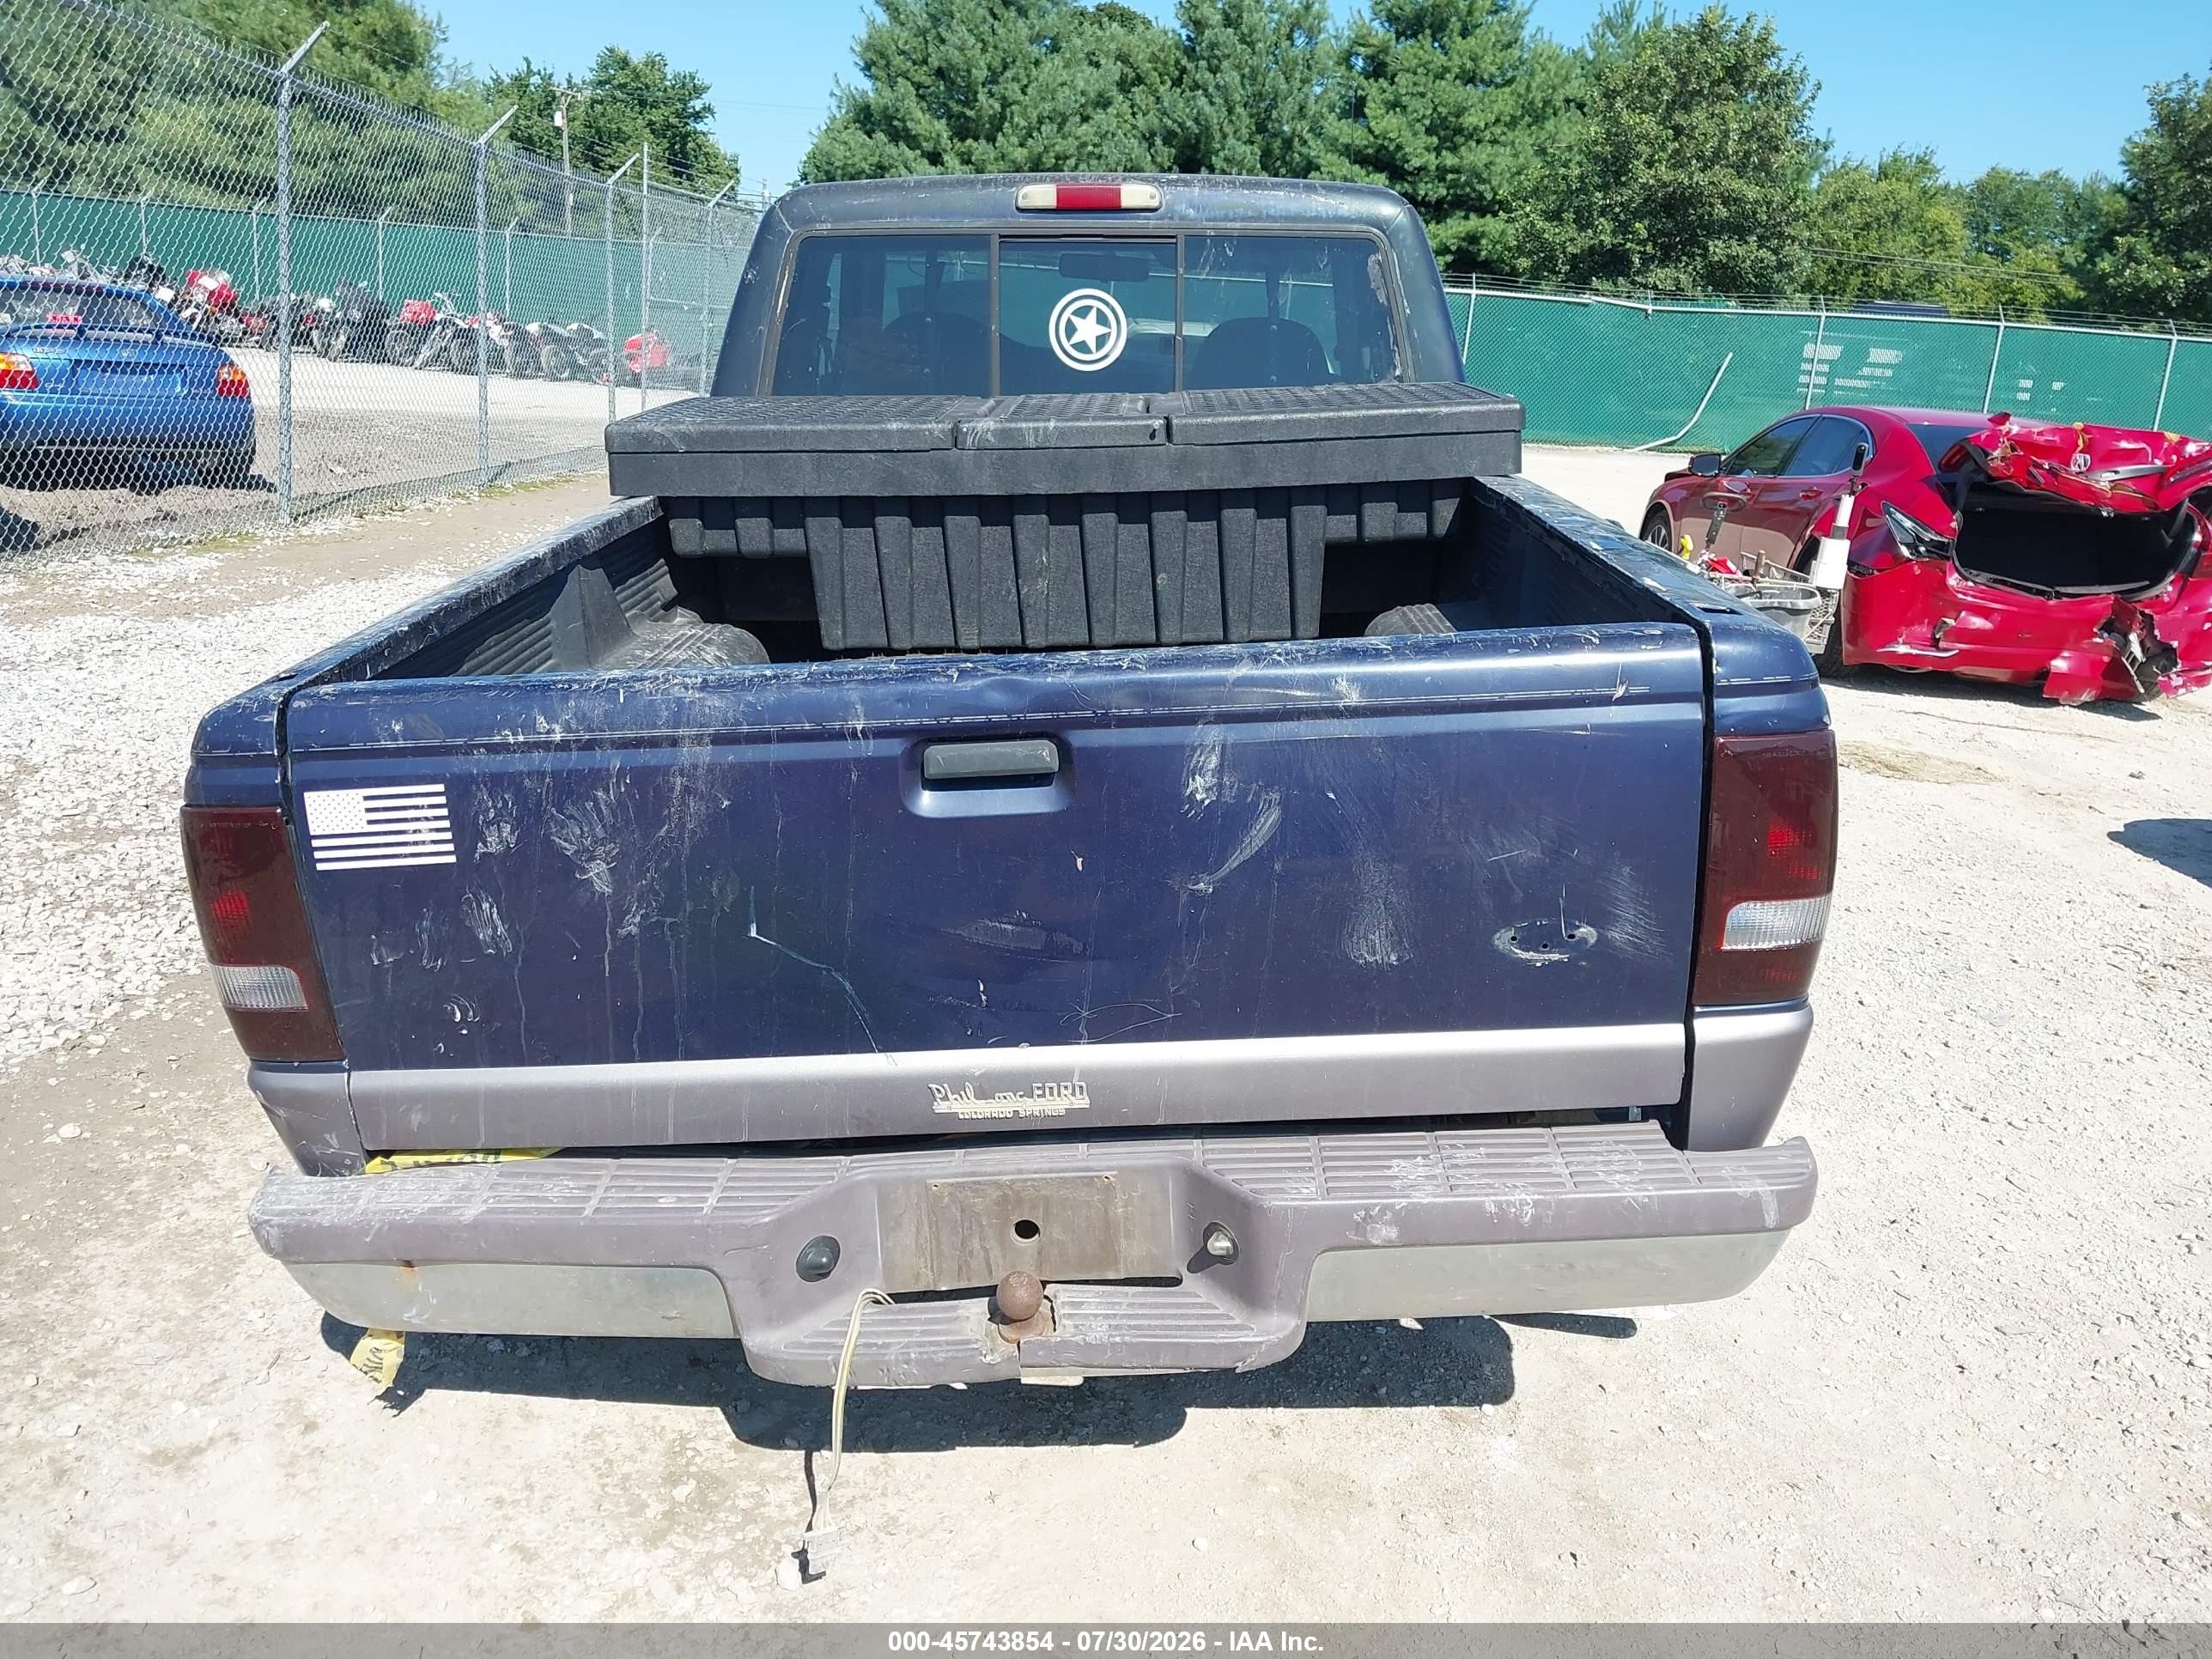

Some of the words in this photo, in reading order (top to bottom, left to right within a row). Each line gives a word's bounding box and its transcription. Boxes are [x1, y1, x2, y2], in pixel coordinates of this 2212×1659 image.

[928, 1082, 976, 1105] Phil
[1032, 1082, 1087, 1101] FORD
[957, 1109, 1013, 1120] COLORADO
[1018, 1109, 1066, 1119] SPRINGS
